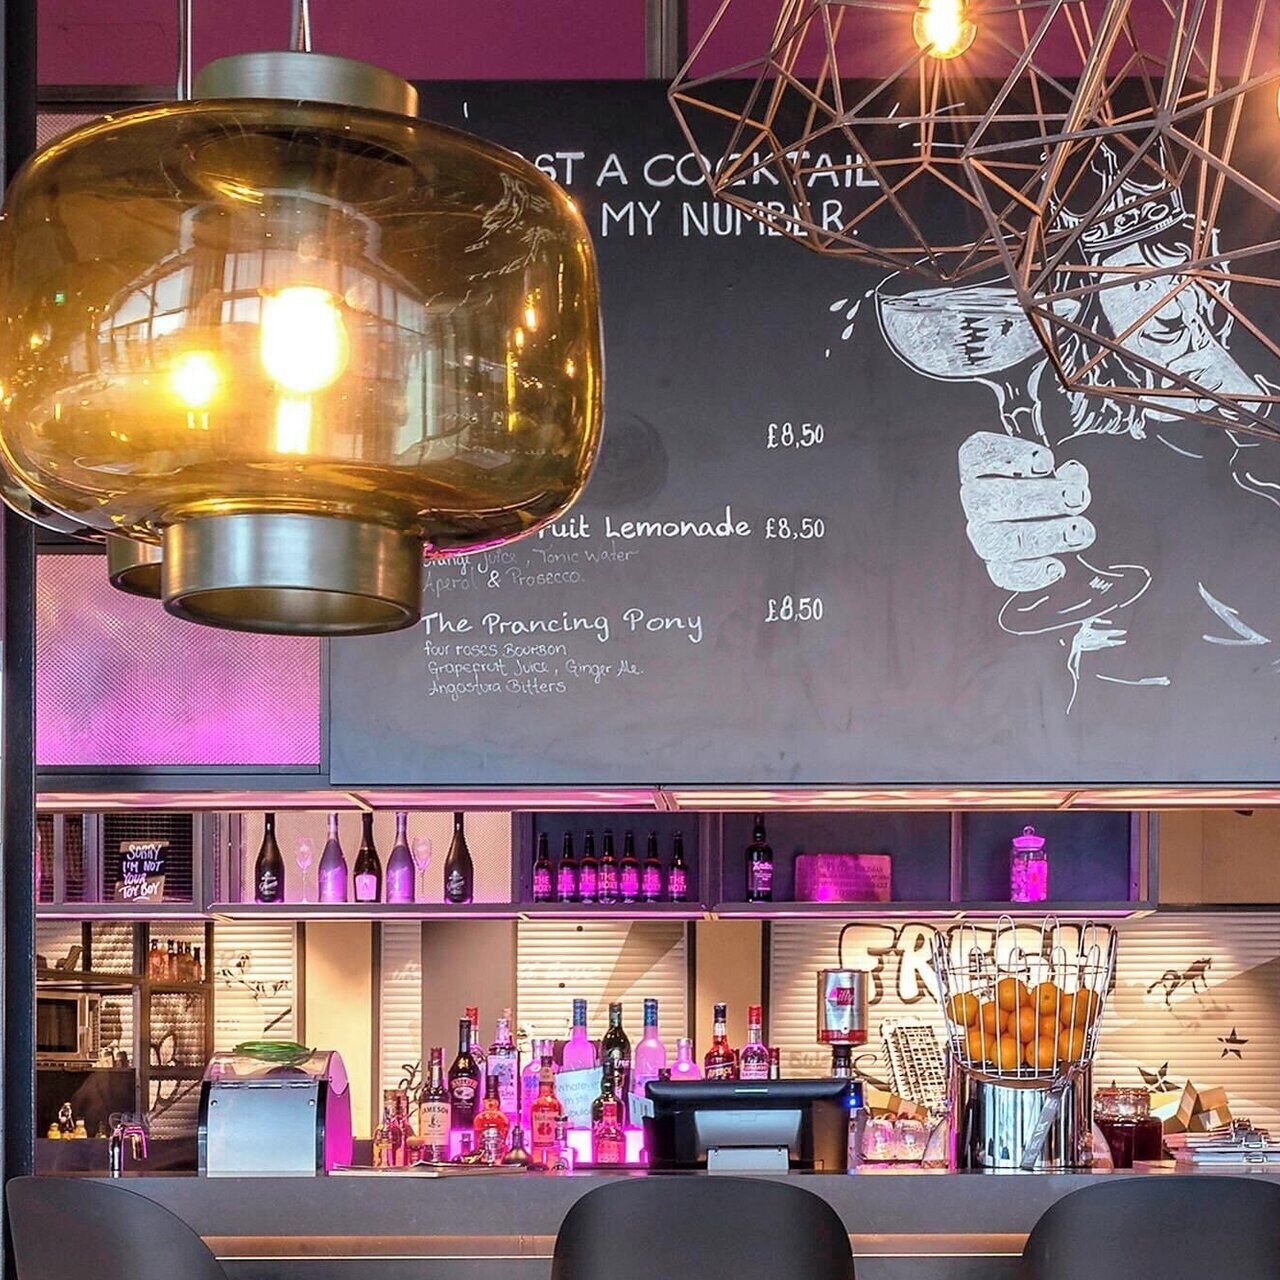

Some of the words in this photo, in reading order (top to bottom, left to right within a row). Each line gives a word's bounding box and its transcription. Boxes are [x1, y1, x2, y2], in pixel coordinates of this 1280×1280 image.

[515, 150, 585, 185] ST
[596, 152, 629, 187] A
[643, 152, 881, 188] COCKTAIL
[601, 199, 662, 237] MY
[537, 513, 591, 540] ruit
[605, 505, 752, 539] Lemonade
[487, 569, 501, 589] &
[422, 612, 473, 635] The
[482, 612, 610, 642] Prancing
[623, 608, 703, 643] Pony
[505, 678, 567, 694] Bitters
[126, 843, 162, 861] SORRY
[122, 861, 139, 873] I'M
[143, 860, 165, 872] NOT
[122, 871, 148, 885] YOUR
[118, 884, 140, 899] TOY
[140, 881, 161, 896] BOY
